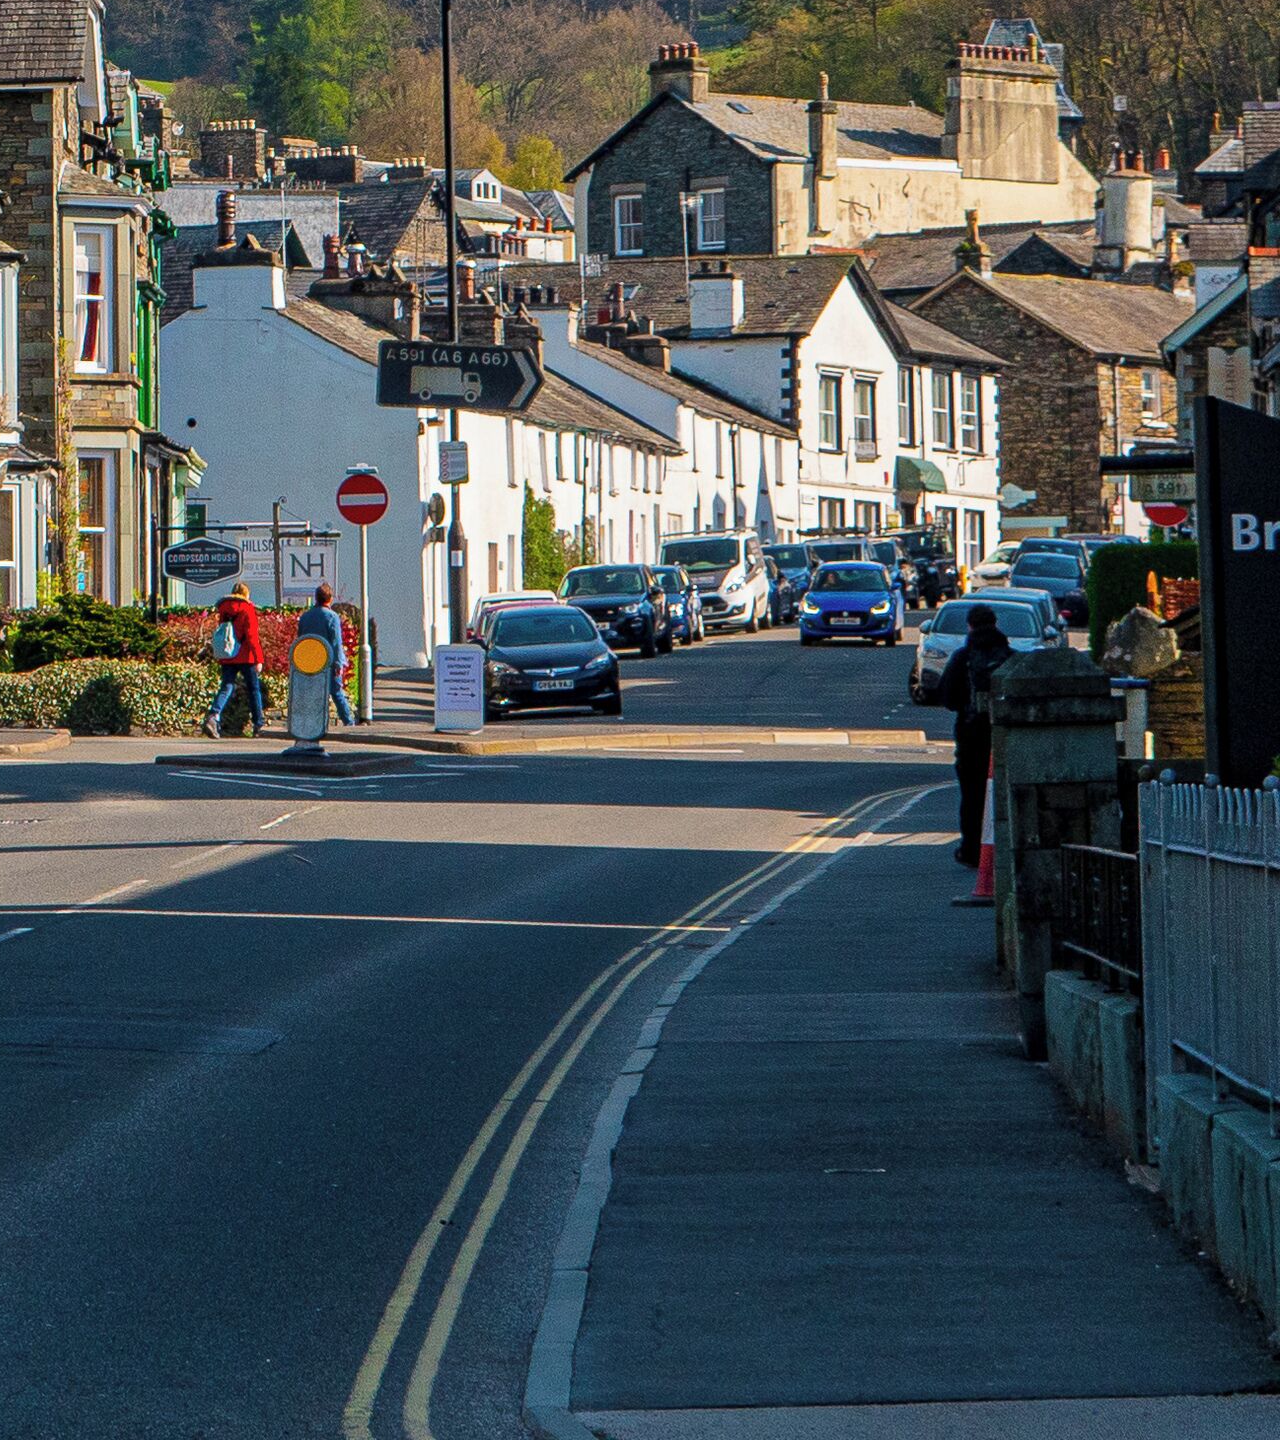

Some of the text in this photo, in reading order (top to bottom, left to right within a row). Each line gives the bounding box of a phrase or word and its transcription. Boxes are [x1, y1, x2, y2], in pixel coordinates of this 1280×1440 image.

[386, 347, 510, 367] A591 (A6 A66)
[289, 552, 325, 578] NH
